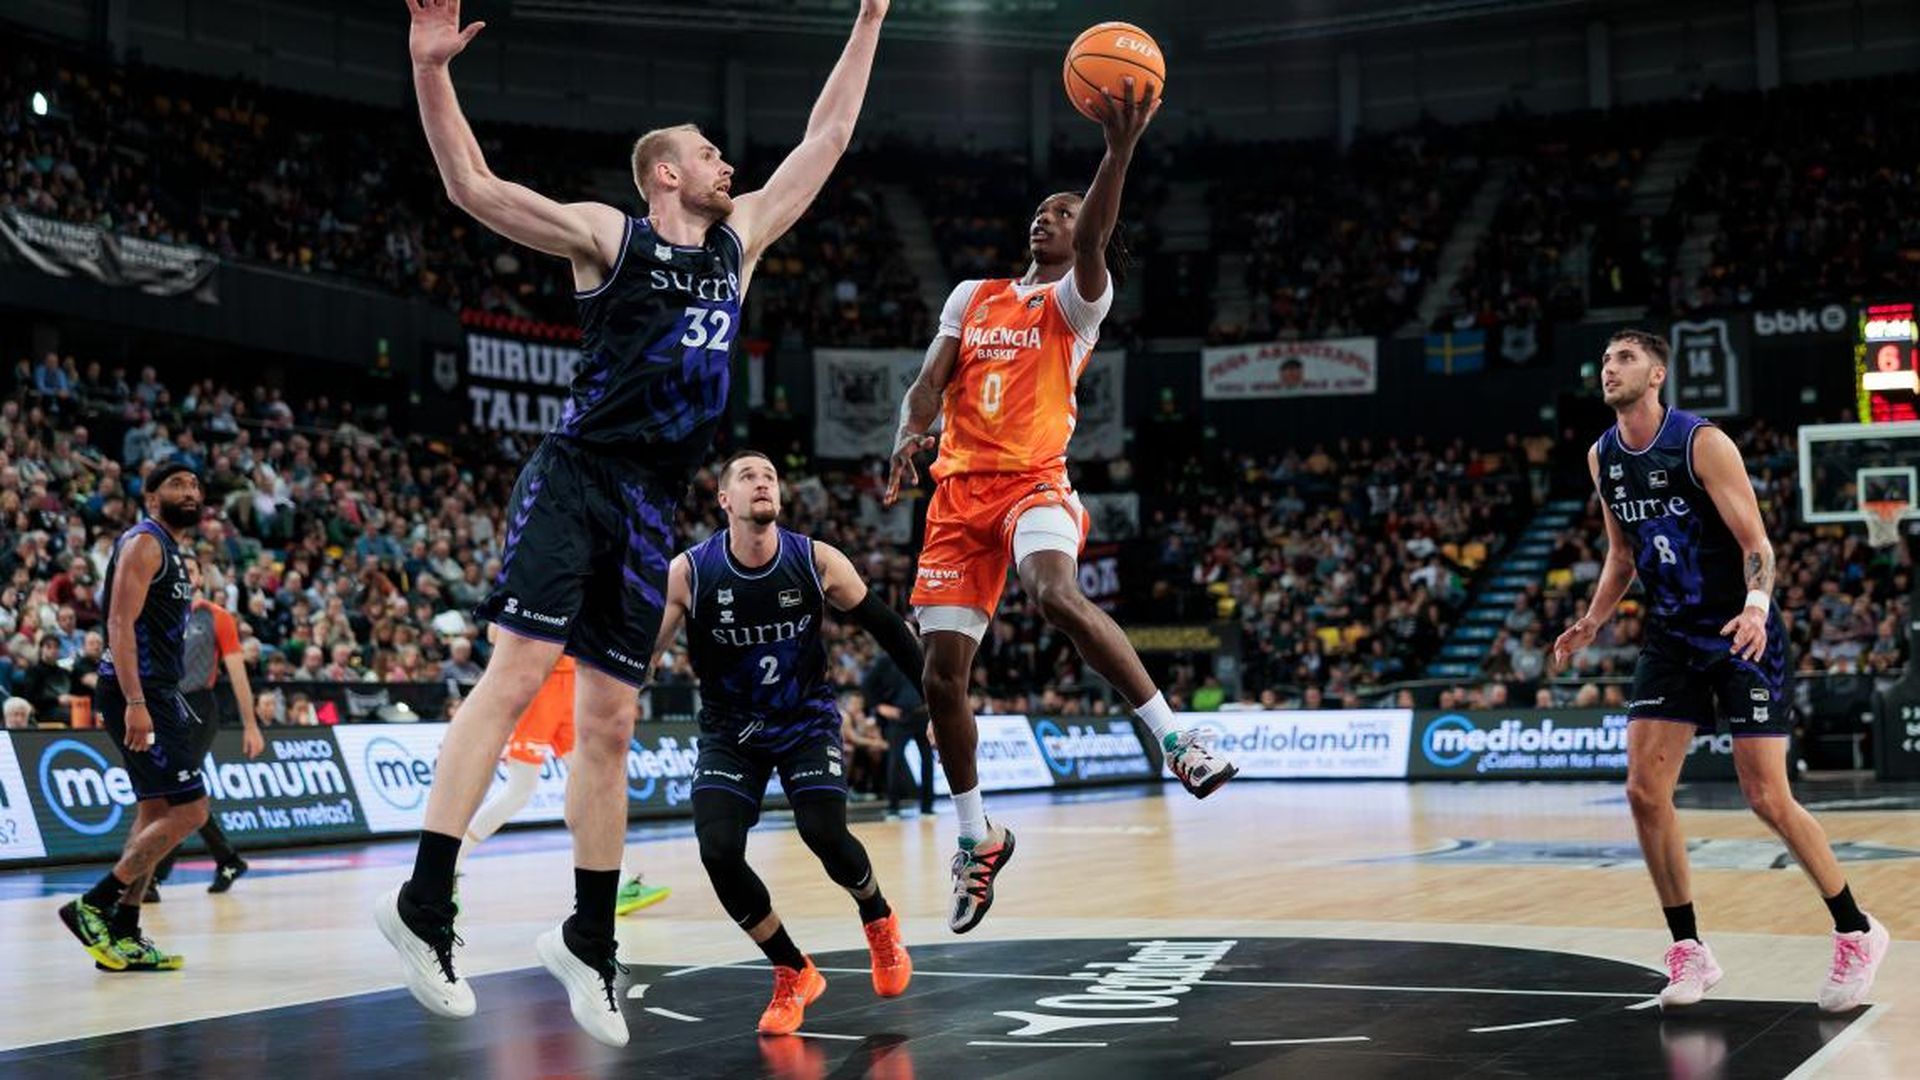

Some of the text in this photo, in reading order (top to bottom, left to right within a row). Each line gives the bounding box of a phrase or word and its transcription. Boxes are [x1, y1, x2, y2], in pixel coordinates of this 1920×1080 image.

[681, 307, 731, 350] 32
[964, 326, 1041, 349] VALENCIA
[1755, 310, 1818, 335] bbk
[468, 334, 581, 386] HIRUK
[983, 372, 1002, 413] 0
[468, 386, 562, 434] TALD
[1653, 535, 1676, 565] 8
[711, 614, 811, 646] surne
[759, 656, 780, 684] 2
[272, 740, 333, 760] BANCO
[222, 797, 356, 831] son tus metas?
